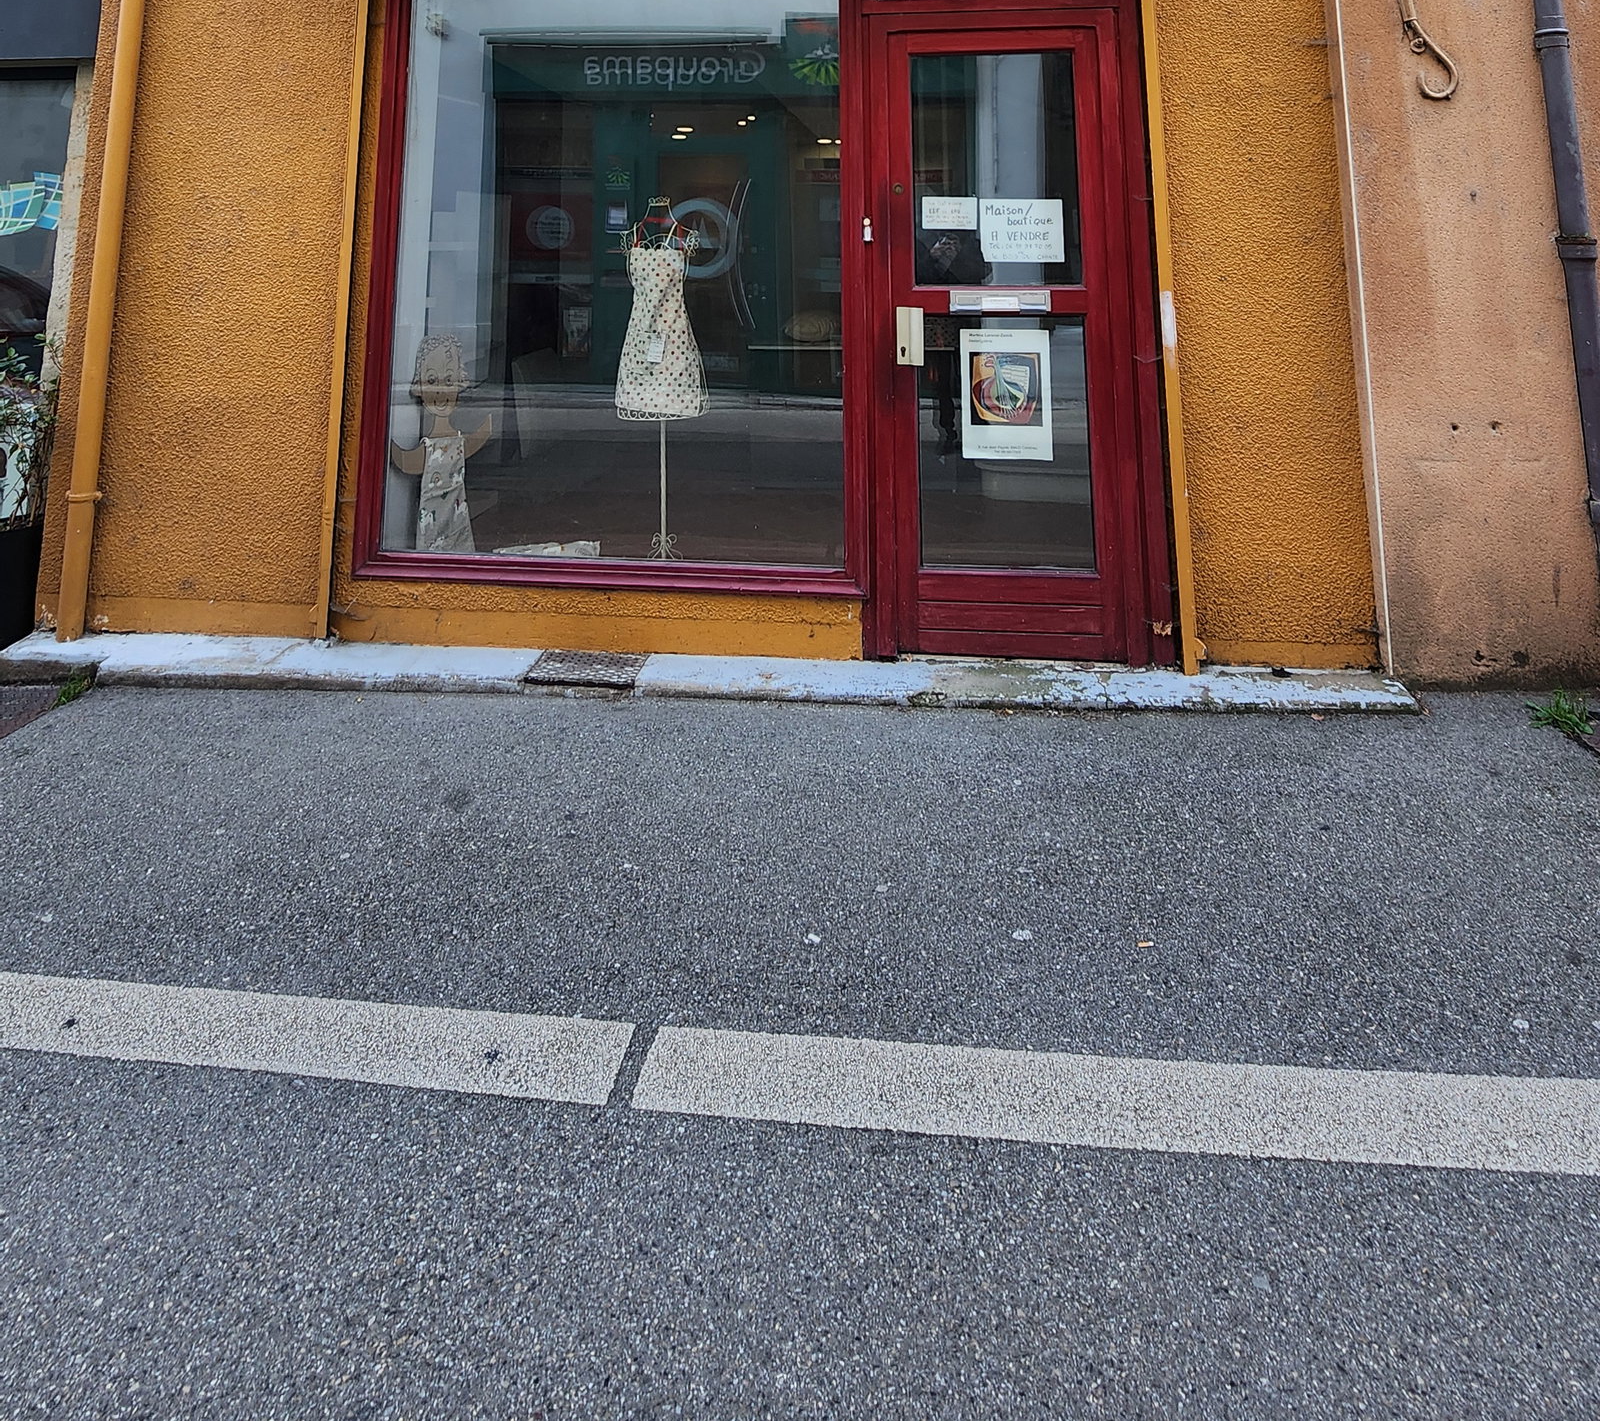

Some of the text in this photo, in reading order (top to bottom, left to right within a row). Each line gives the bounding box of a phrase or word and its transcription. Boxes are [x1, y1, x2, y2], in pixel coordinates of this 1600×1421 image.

[1007, 216, 1054, 227] boutique
[991, 230, 1050, 242] A VENDRE
